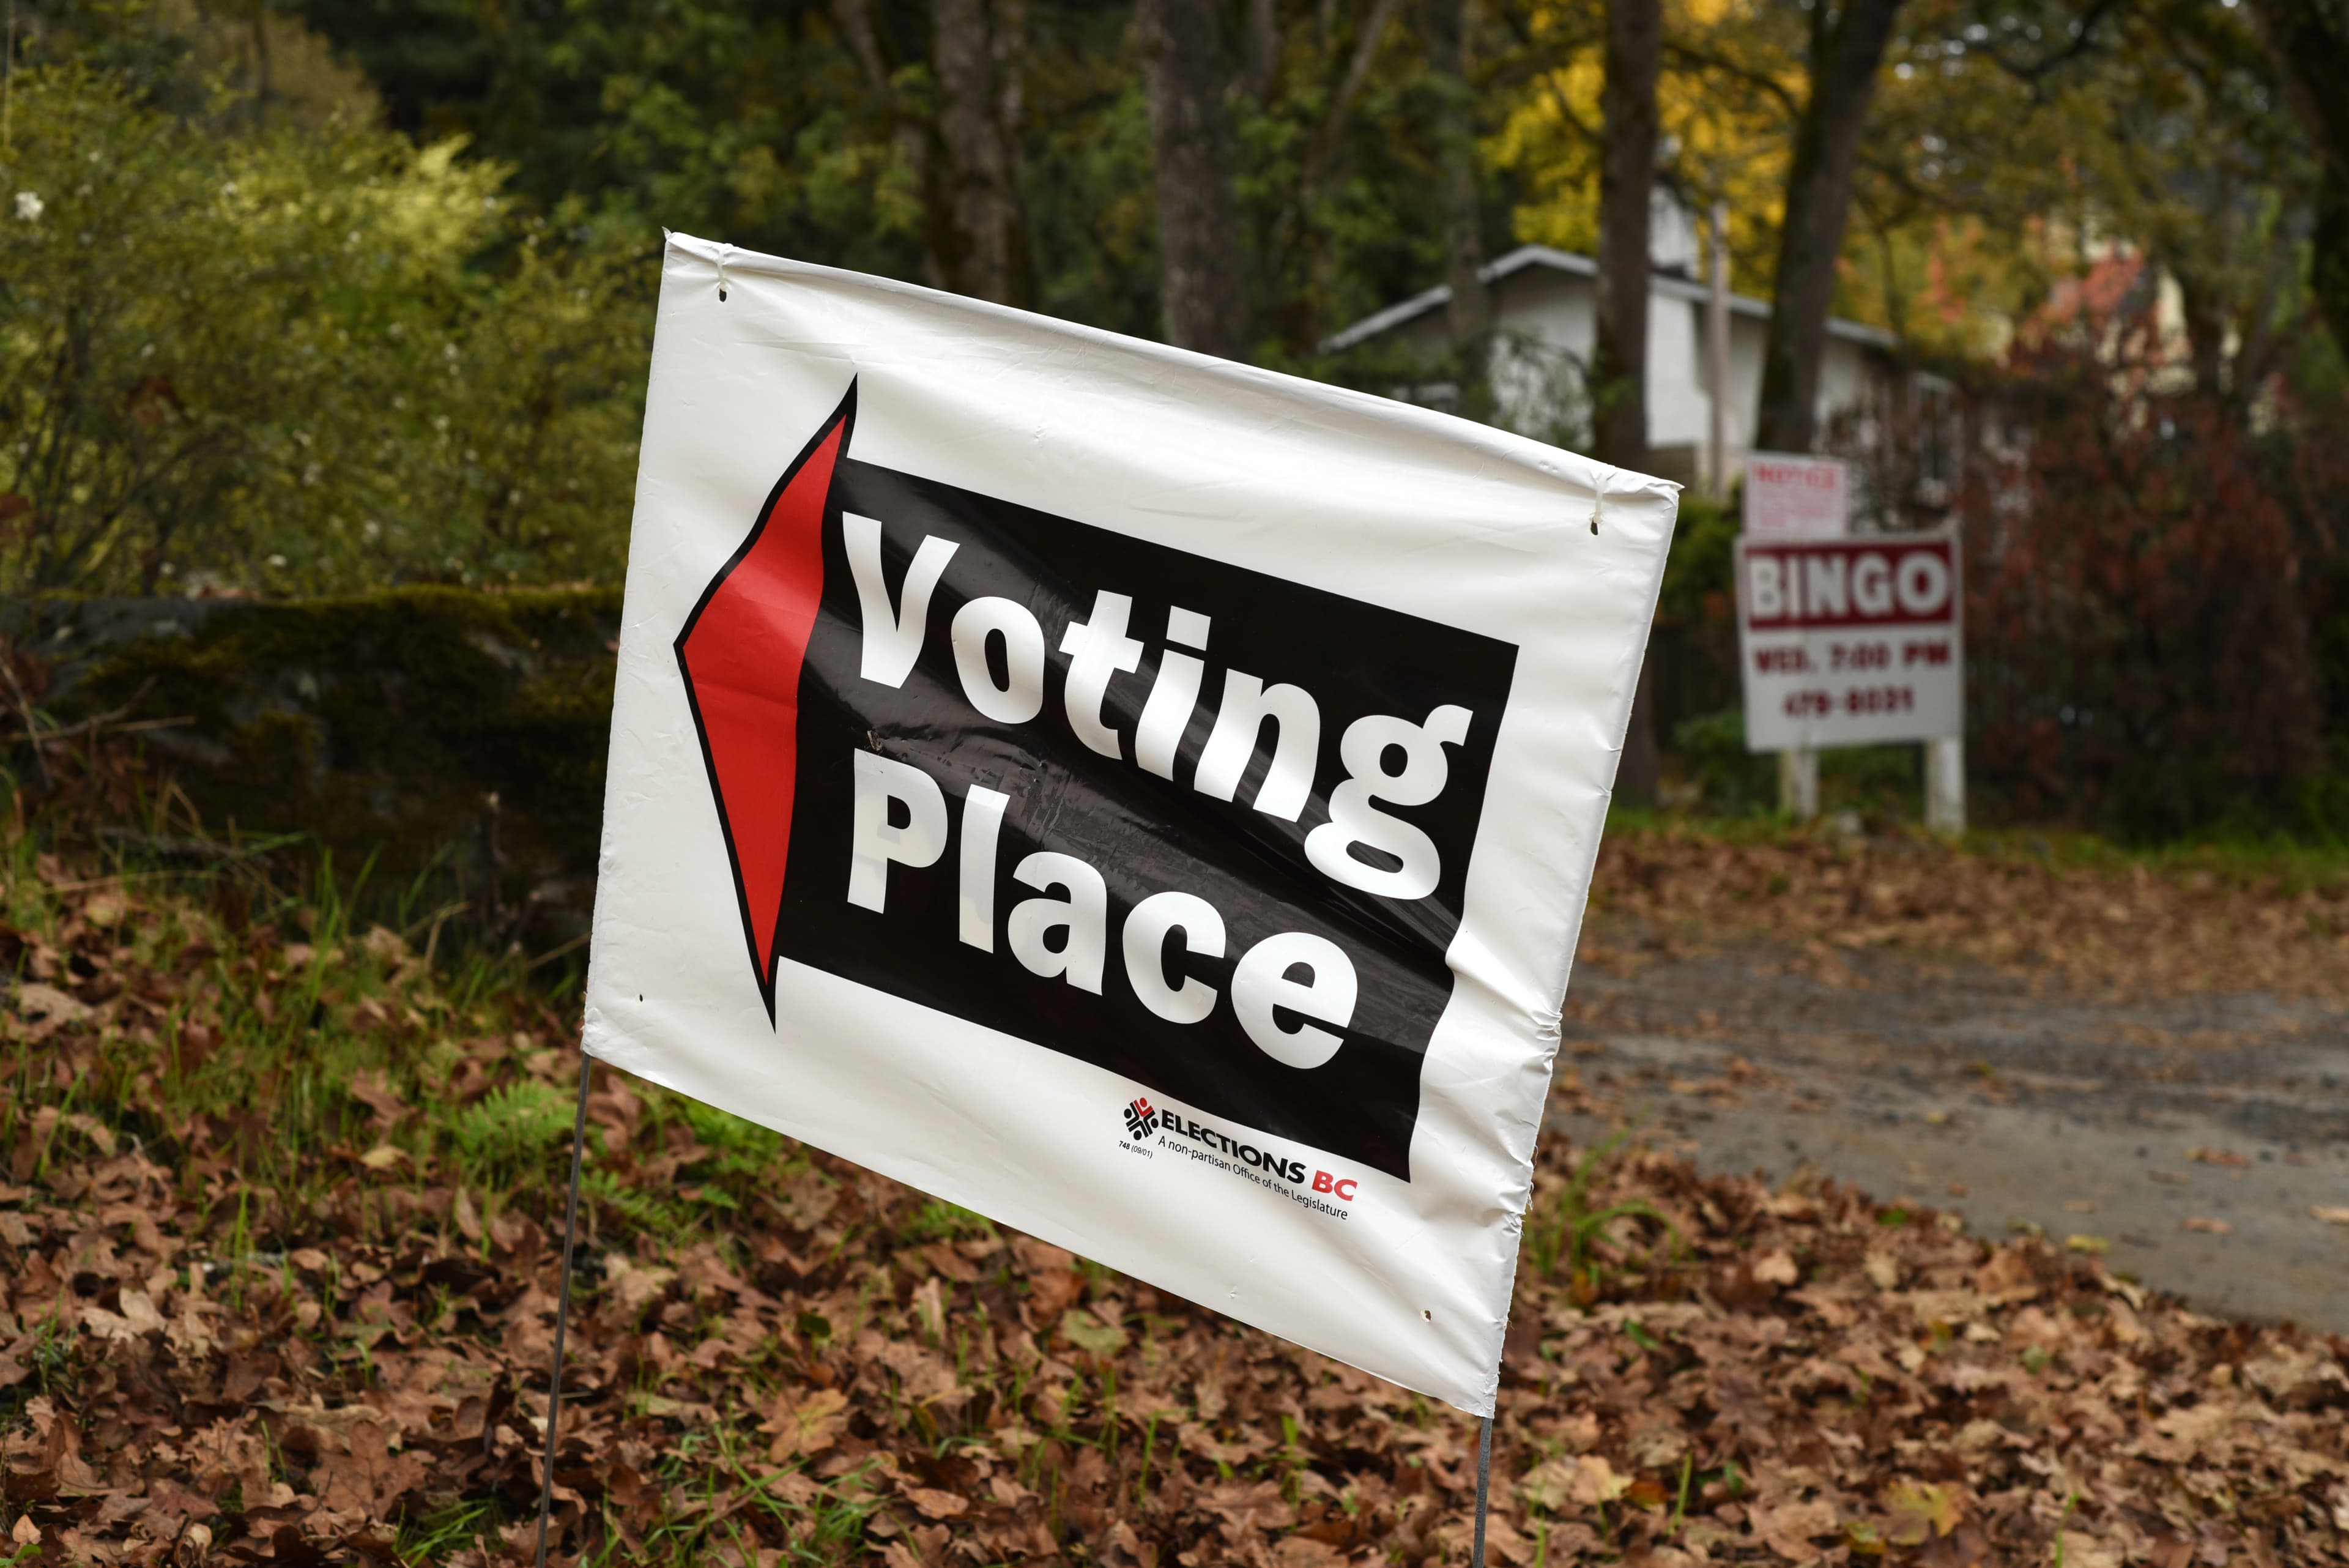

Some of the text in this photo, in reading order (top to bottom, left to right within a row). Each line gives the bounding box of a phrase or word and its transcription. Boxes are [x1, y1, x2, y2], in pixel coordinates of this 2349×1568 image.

[1748, 552, 1950, 619] BINGO
[1830, 642, 1891, 671] 7:00
[1902, 639, 1951, 667] PM
[842, 511, 1473, 900] Voting
[847, 748, 1357, 1069] Place
[1119, 1140, 1152, 1159] 748 (09/01)
[1158, 1135, 1348, 1220] A non-partisan Office of the Legislature
[1162, 1109, 1358, 1201] ELECTIONS BC
